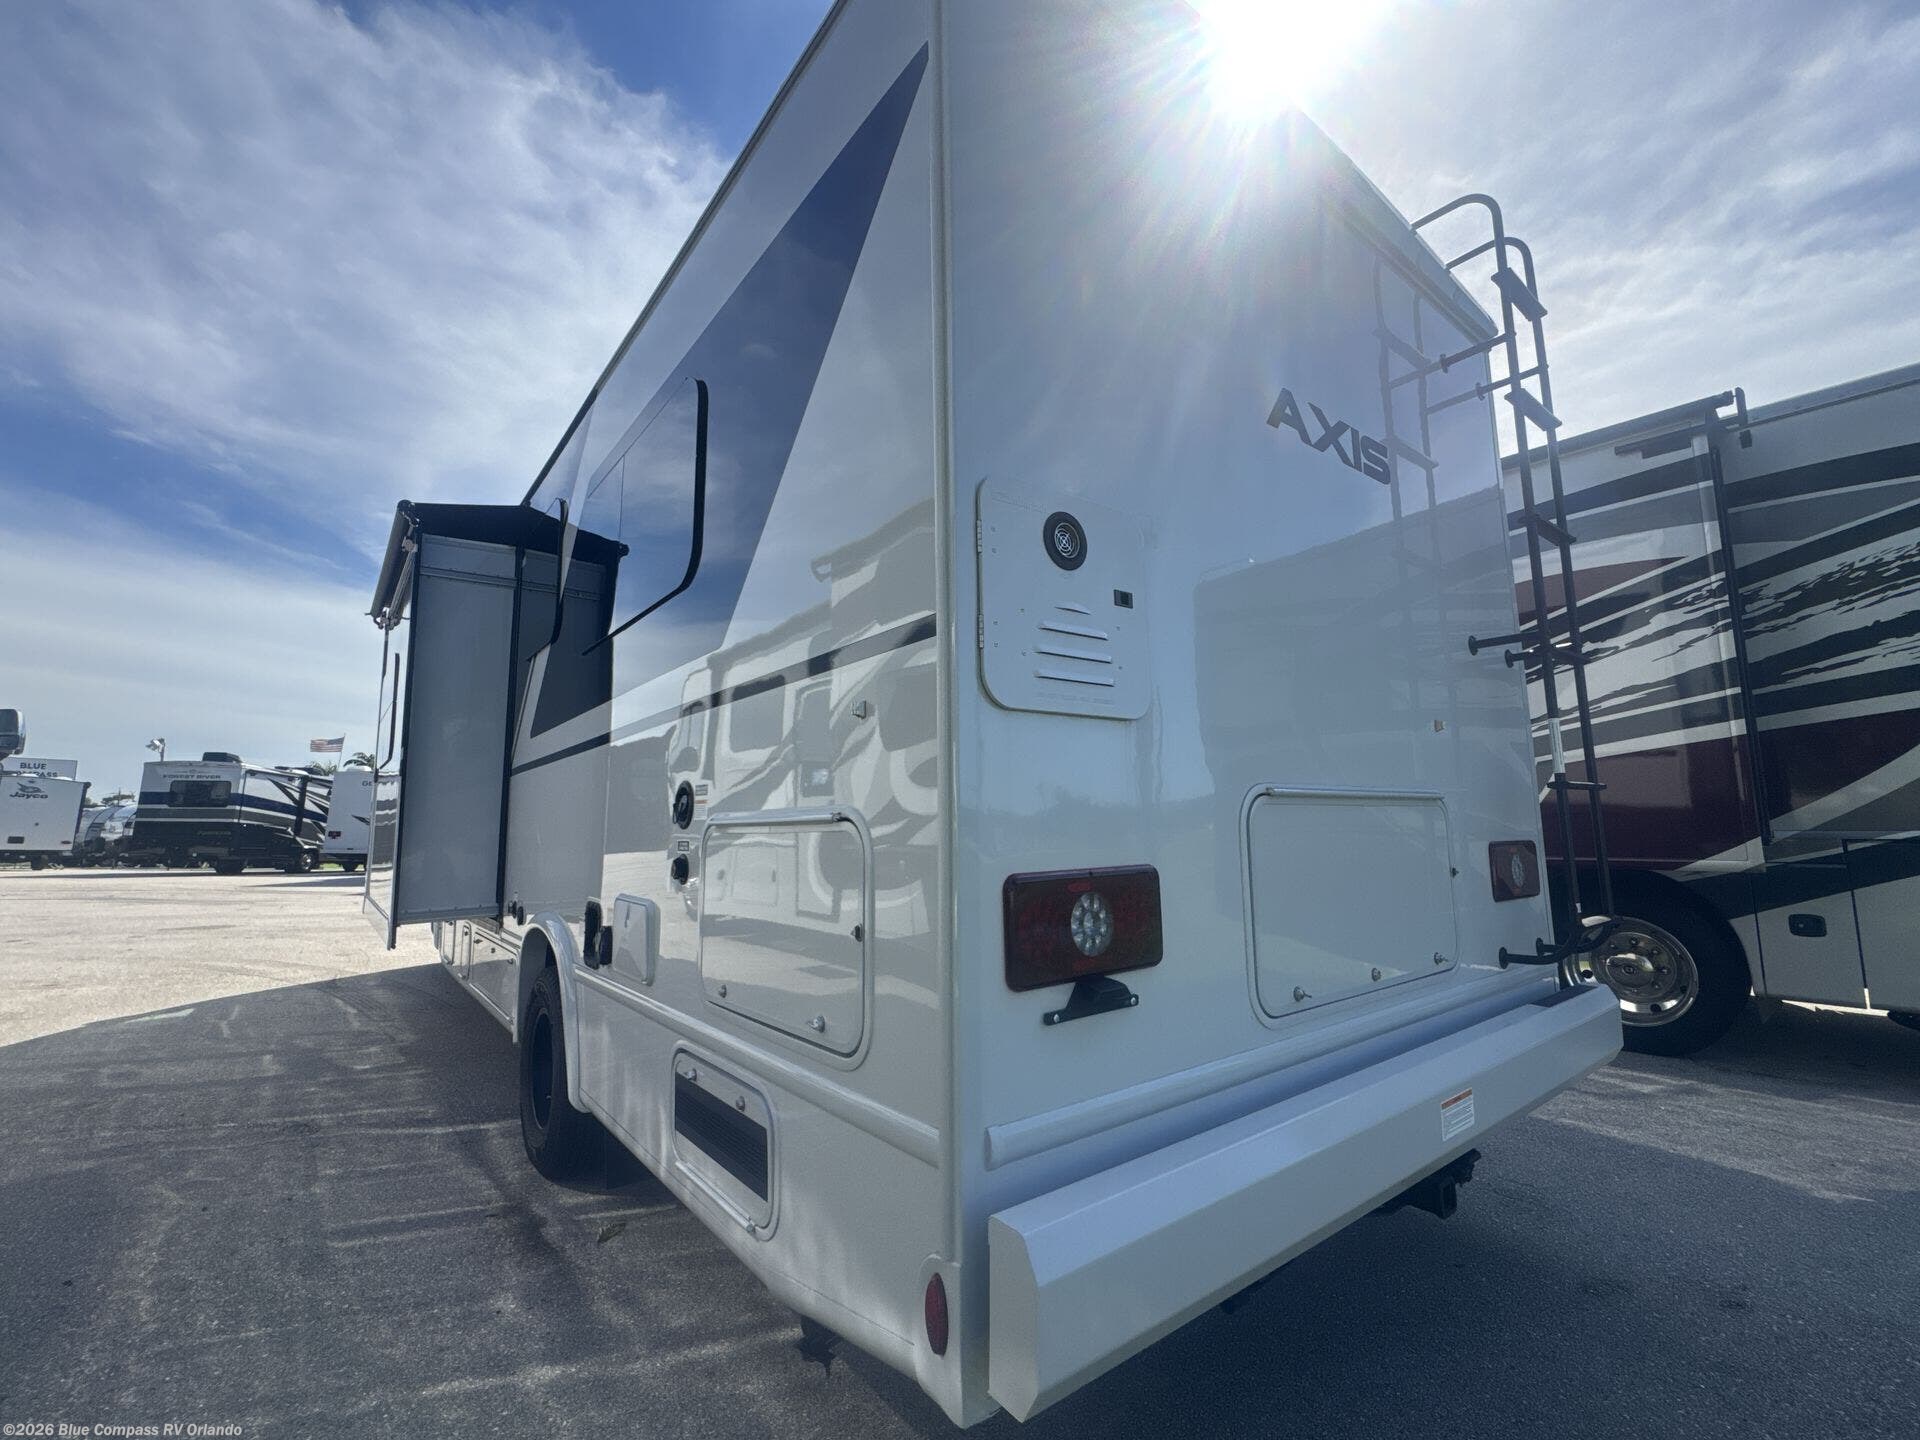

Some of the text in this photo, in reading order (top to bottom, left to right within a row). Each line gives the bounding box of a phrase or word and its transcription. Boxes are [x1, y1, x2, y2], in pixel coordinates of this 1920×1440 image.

[1266, 387, 1391, 485] AXIS
[20, 762, 47, 770] BLUE
[9, 791, 48, 799] Jayco
